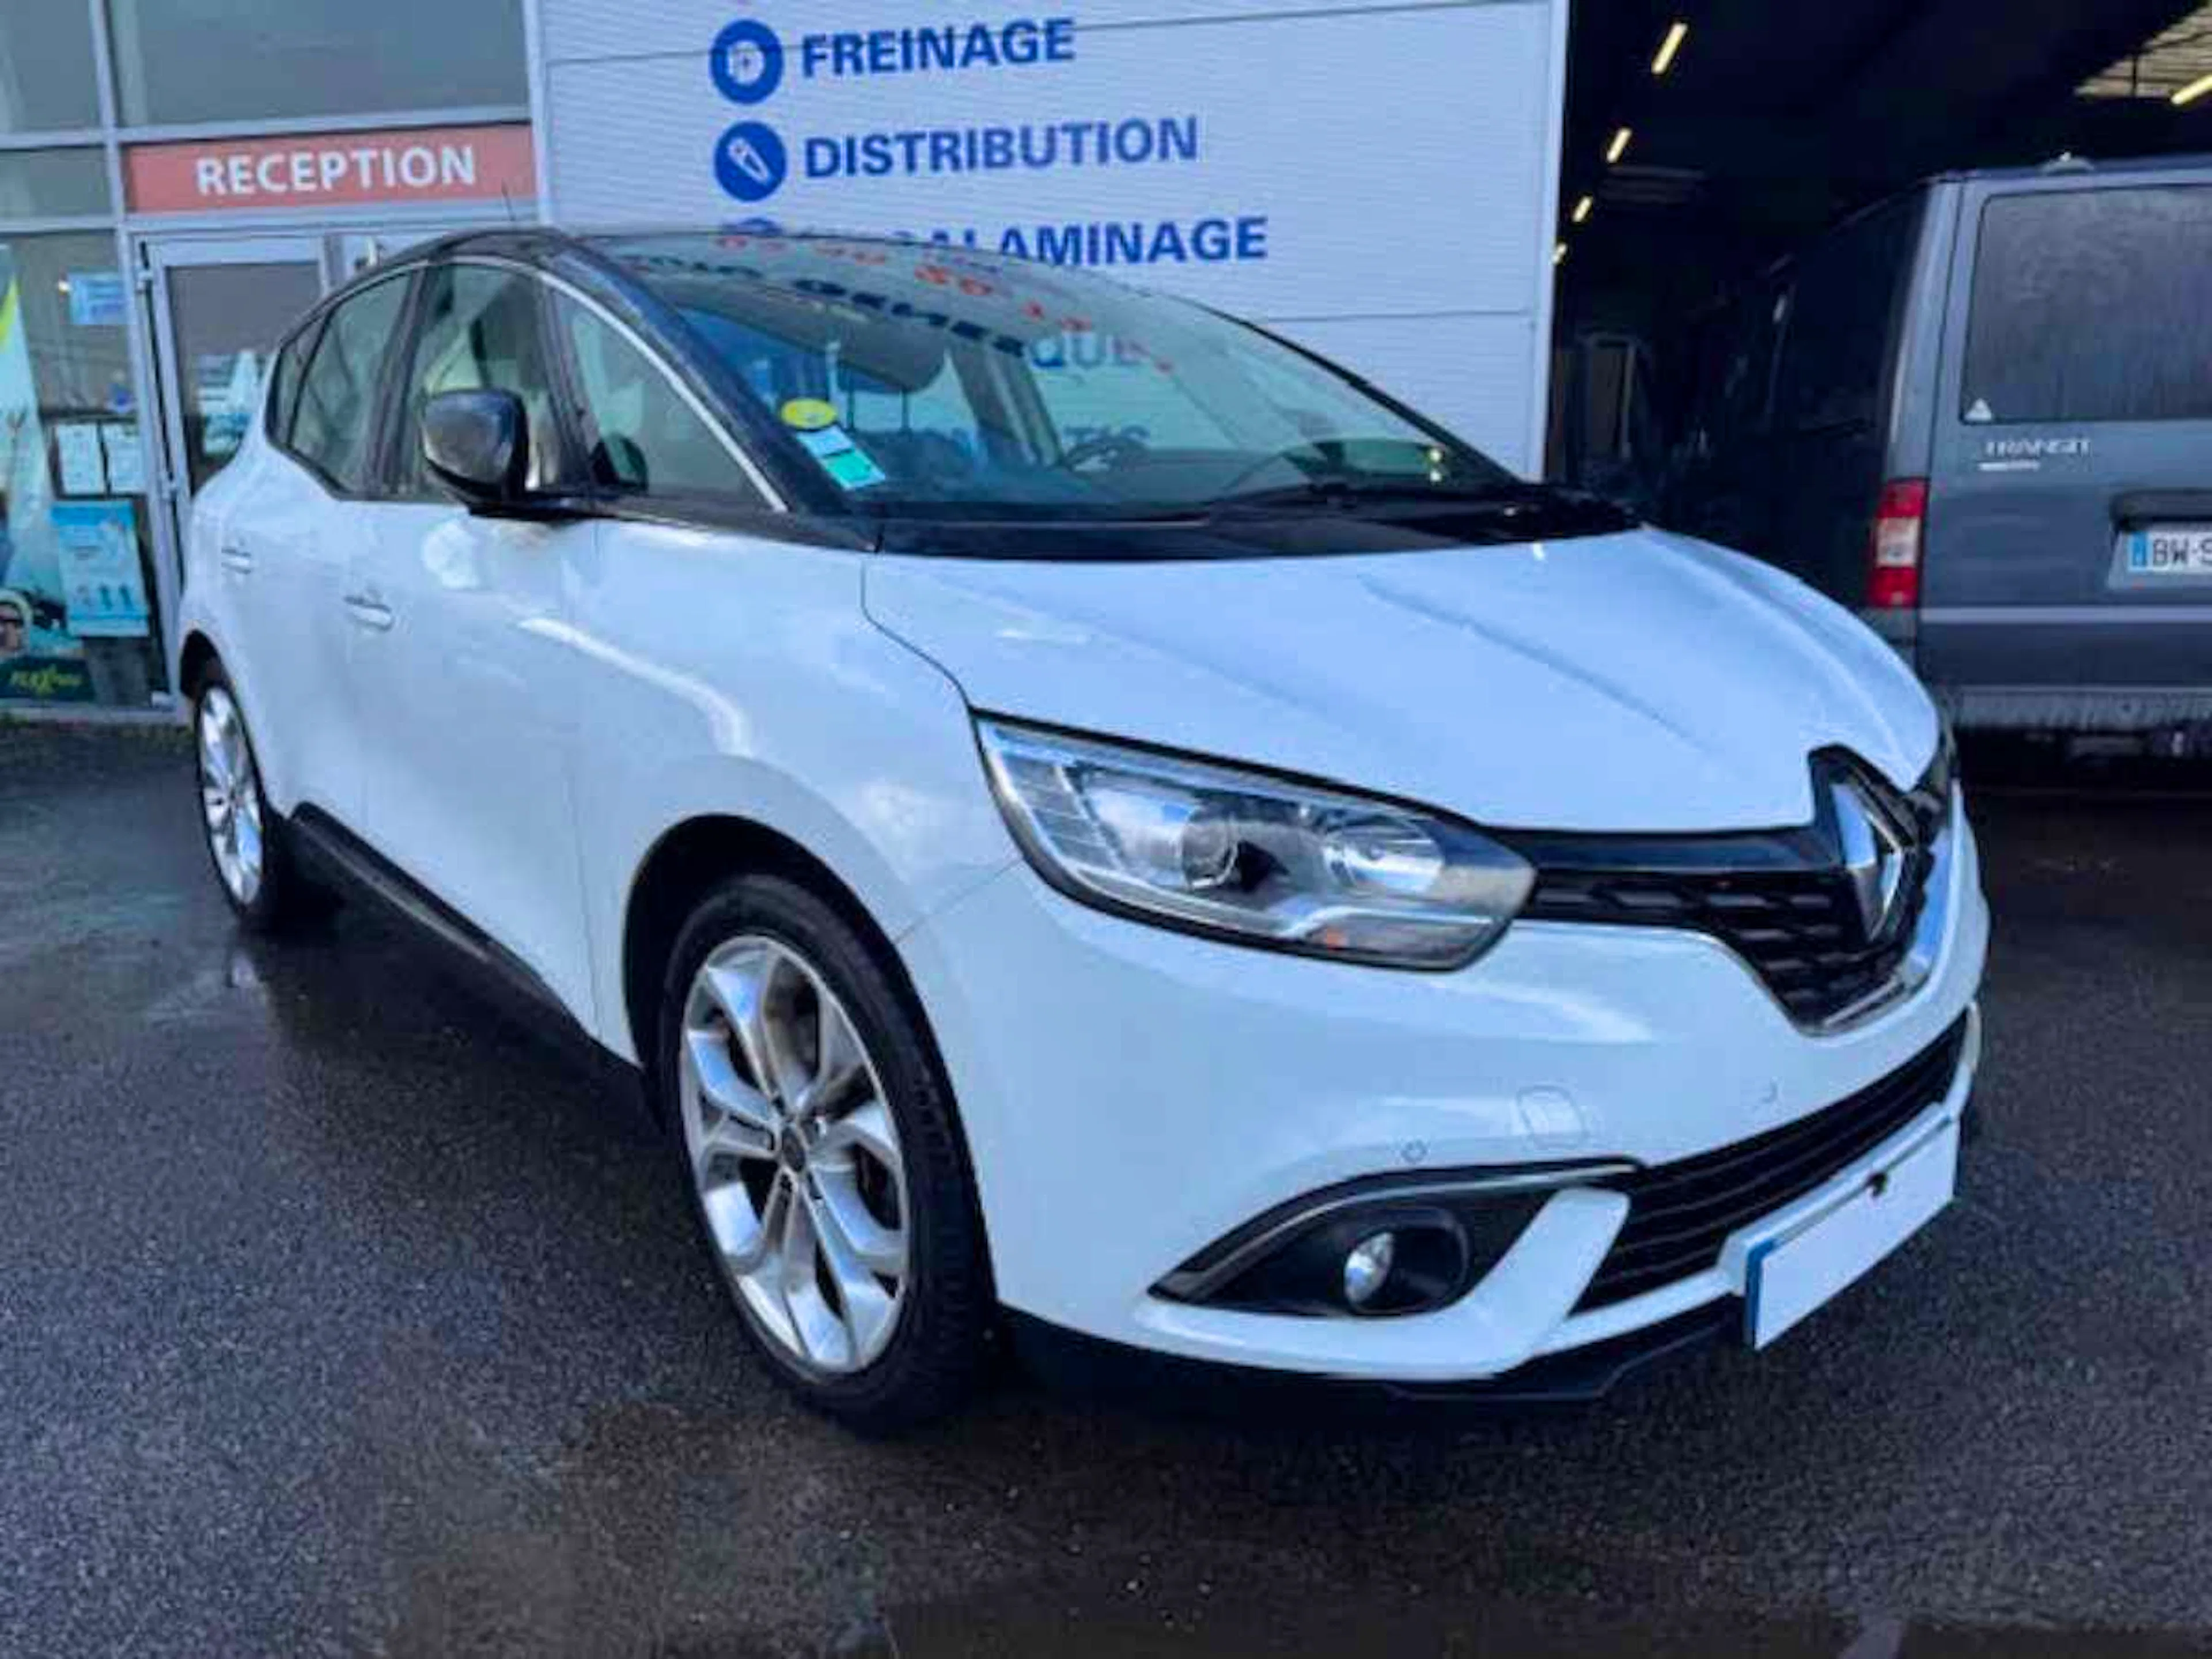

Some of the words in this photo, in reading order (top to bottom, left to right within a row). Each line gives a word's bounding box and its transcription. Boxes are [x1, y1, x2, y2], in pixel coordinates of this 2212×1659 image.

[802, 18, 1075, 77] FREINAGE
[196, 145, 476, 195] RECEPTION
[805, 116, 1197, 177] DISTRIBUTION
